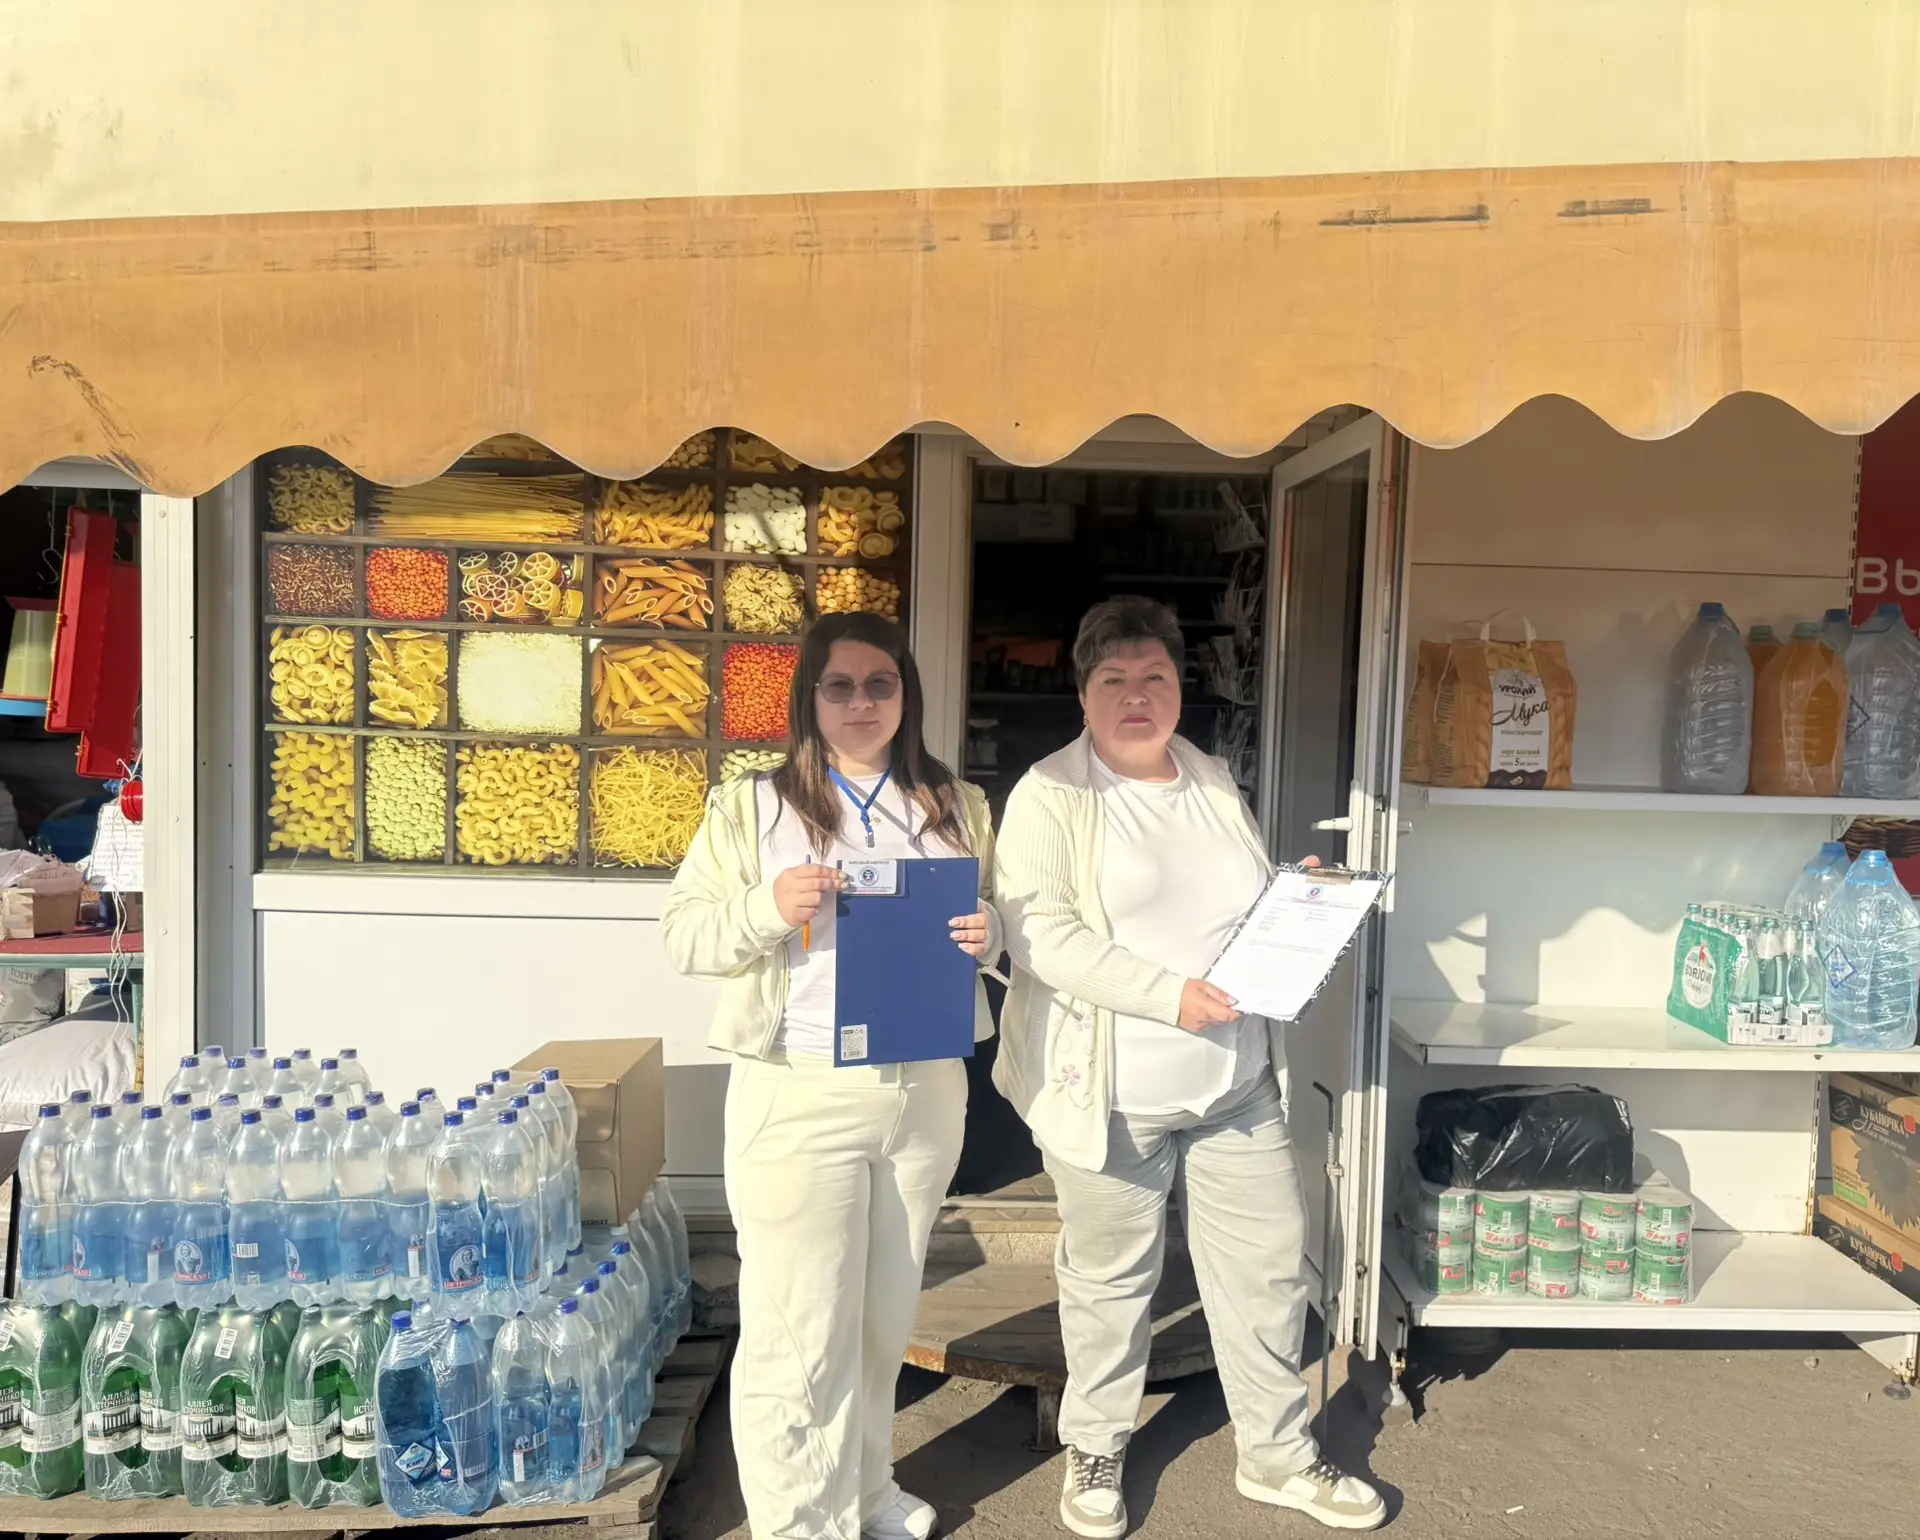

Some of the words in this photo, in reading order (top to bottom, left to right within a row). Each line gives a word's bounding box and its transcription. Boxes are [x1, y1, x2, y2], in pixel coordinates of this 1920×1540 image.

[1489, 700, 1552, 727] Мука
[1514, 757, 1520, 767] 5
[101, 1389, 130, 1402] АЛЛЕЯ
